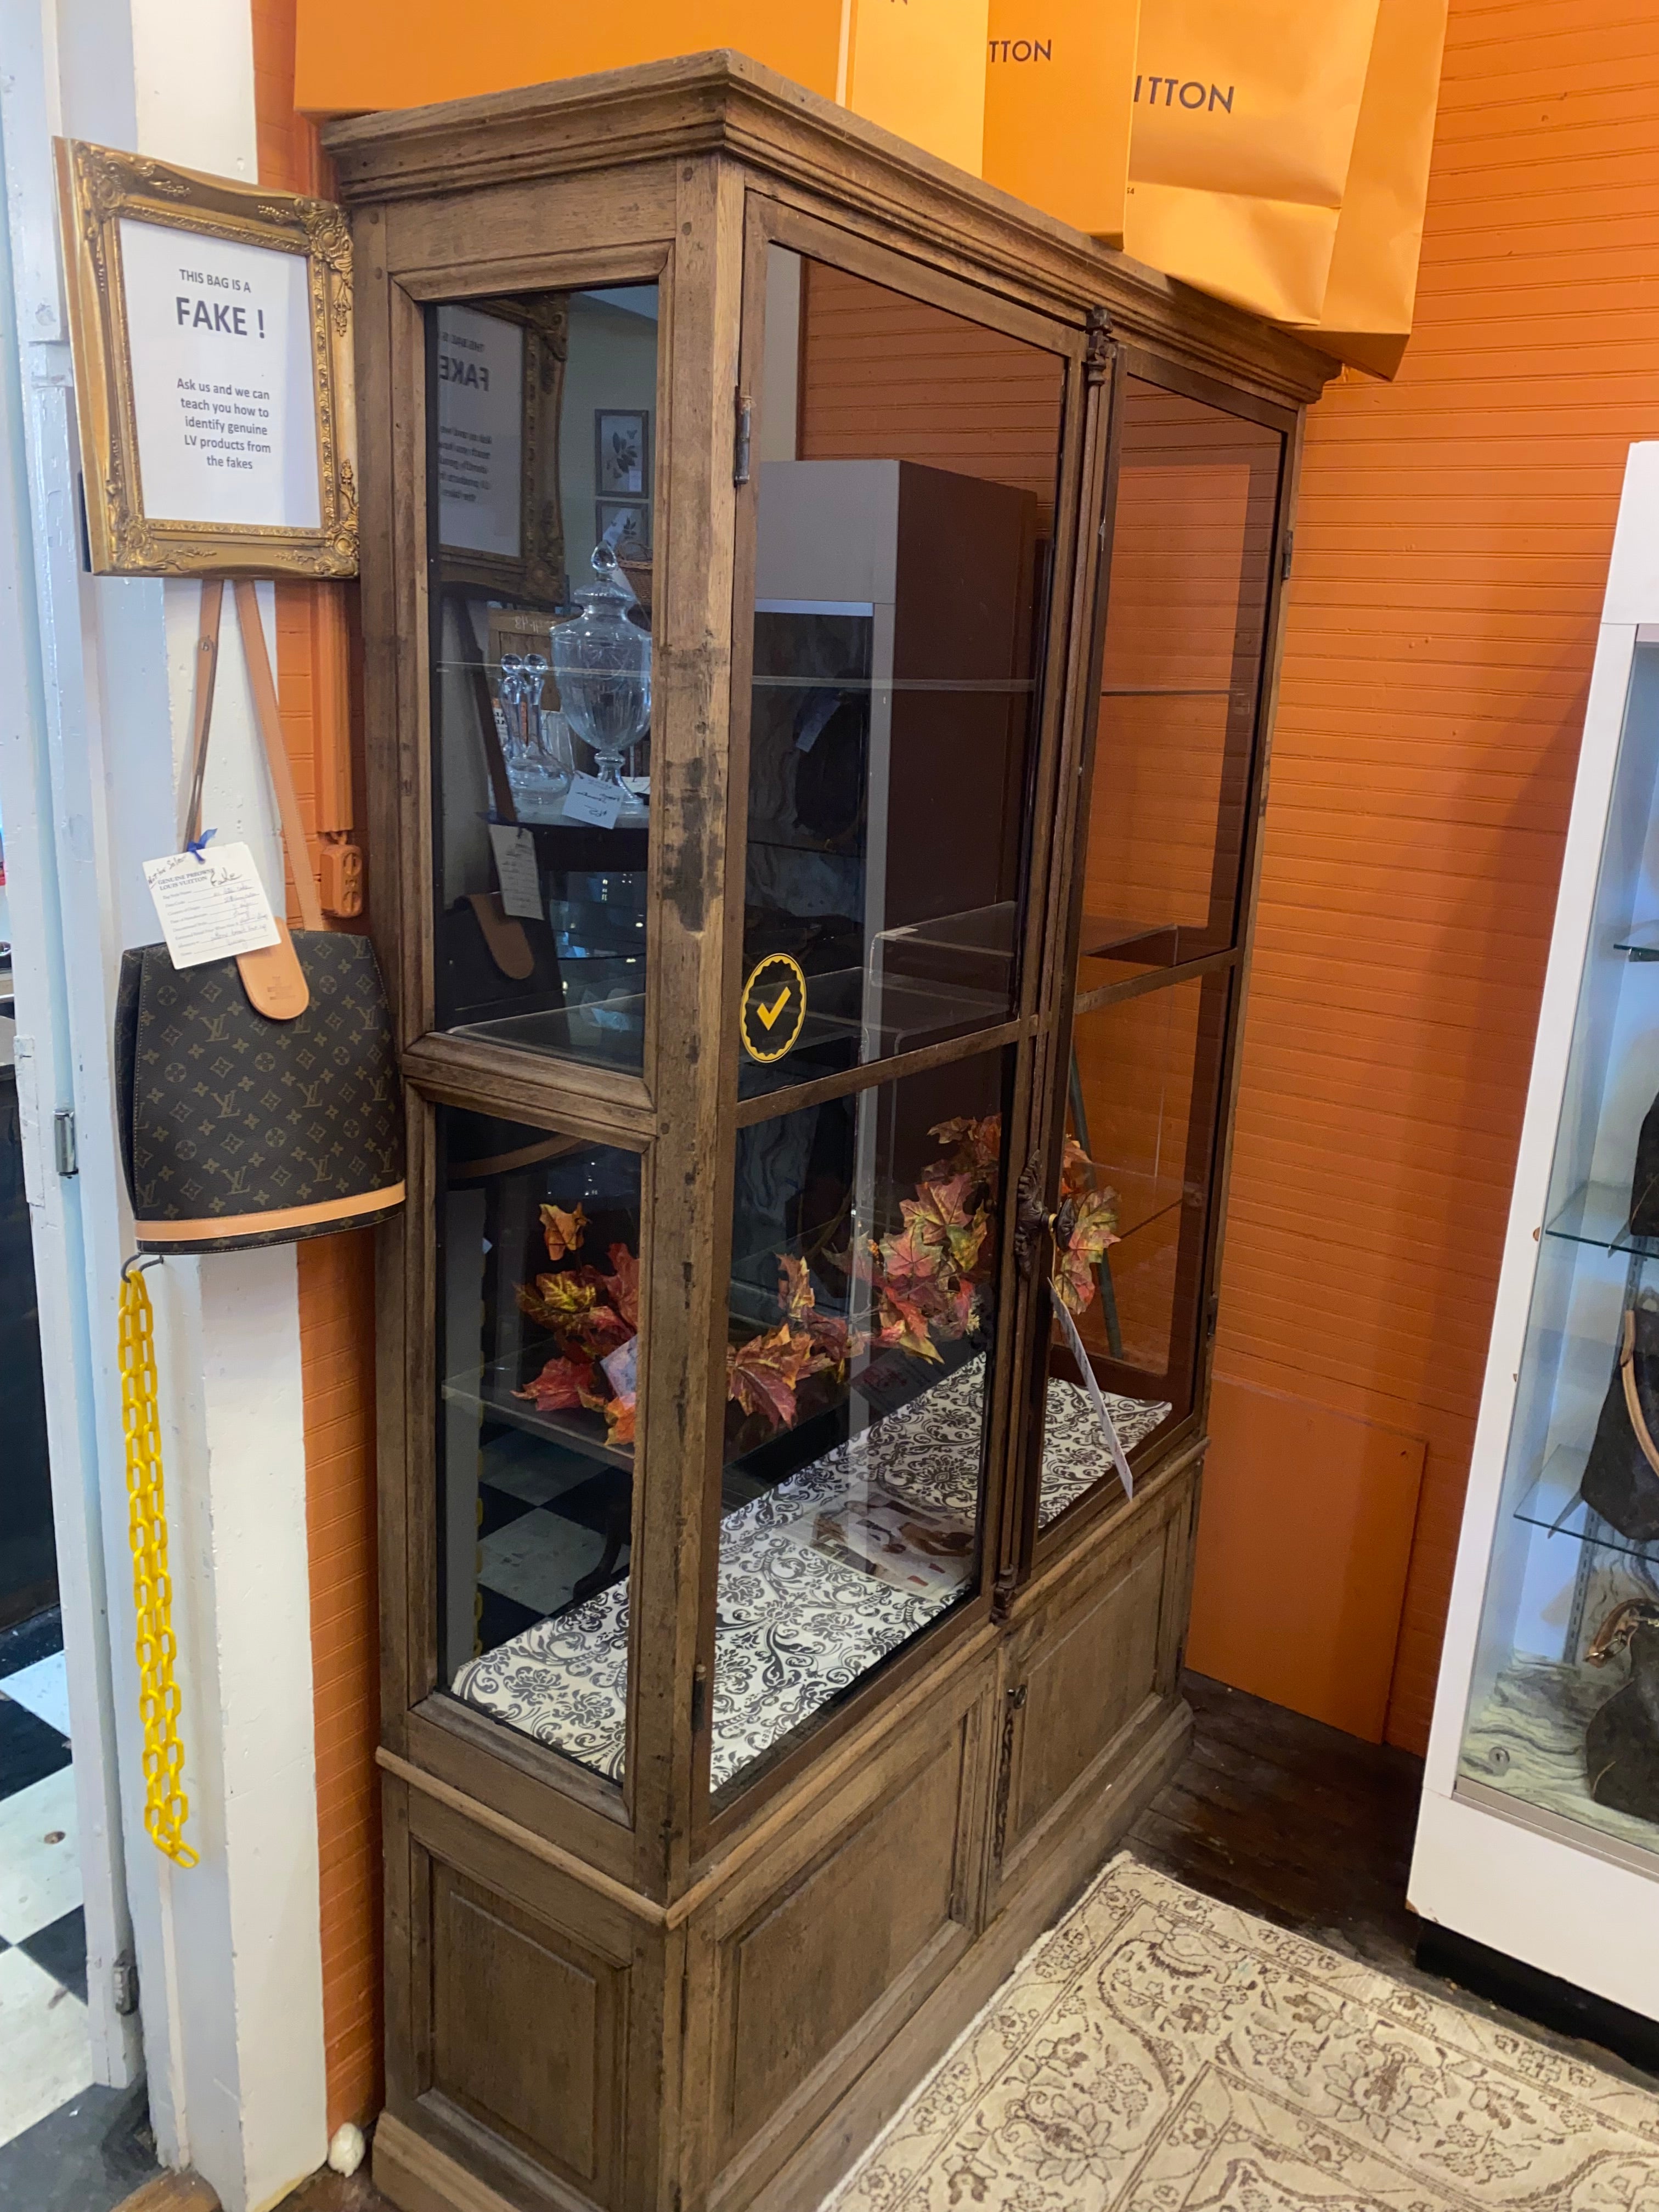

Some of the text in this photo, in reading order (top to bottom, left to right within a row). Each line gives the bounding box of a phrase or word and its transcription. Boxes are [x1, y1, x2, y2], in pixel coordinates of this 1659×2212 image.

[989, 39, 1052, 62] TTON
[1133, 75, 1234, 114] ITTON
[179, 269, 251, 293] THIS BAG IS A
[176, 297, 247, 336] FAKE
[177, 378, 270, 400] Ask us and we can
[180, 398, 269, 417] teach you how to
[185, 416, 268, 435] identify genuine
[184, 435, 271, 453] LV products from
[207, 455, 253, 469] the fakes
[158, 873, 185, 885] GENUINE
[160, 876, 208, 891] LOUIS VUITTON
